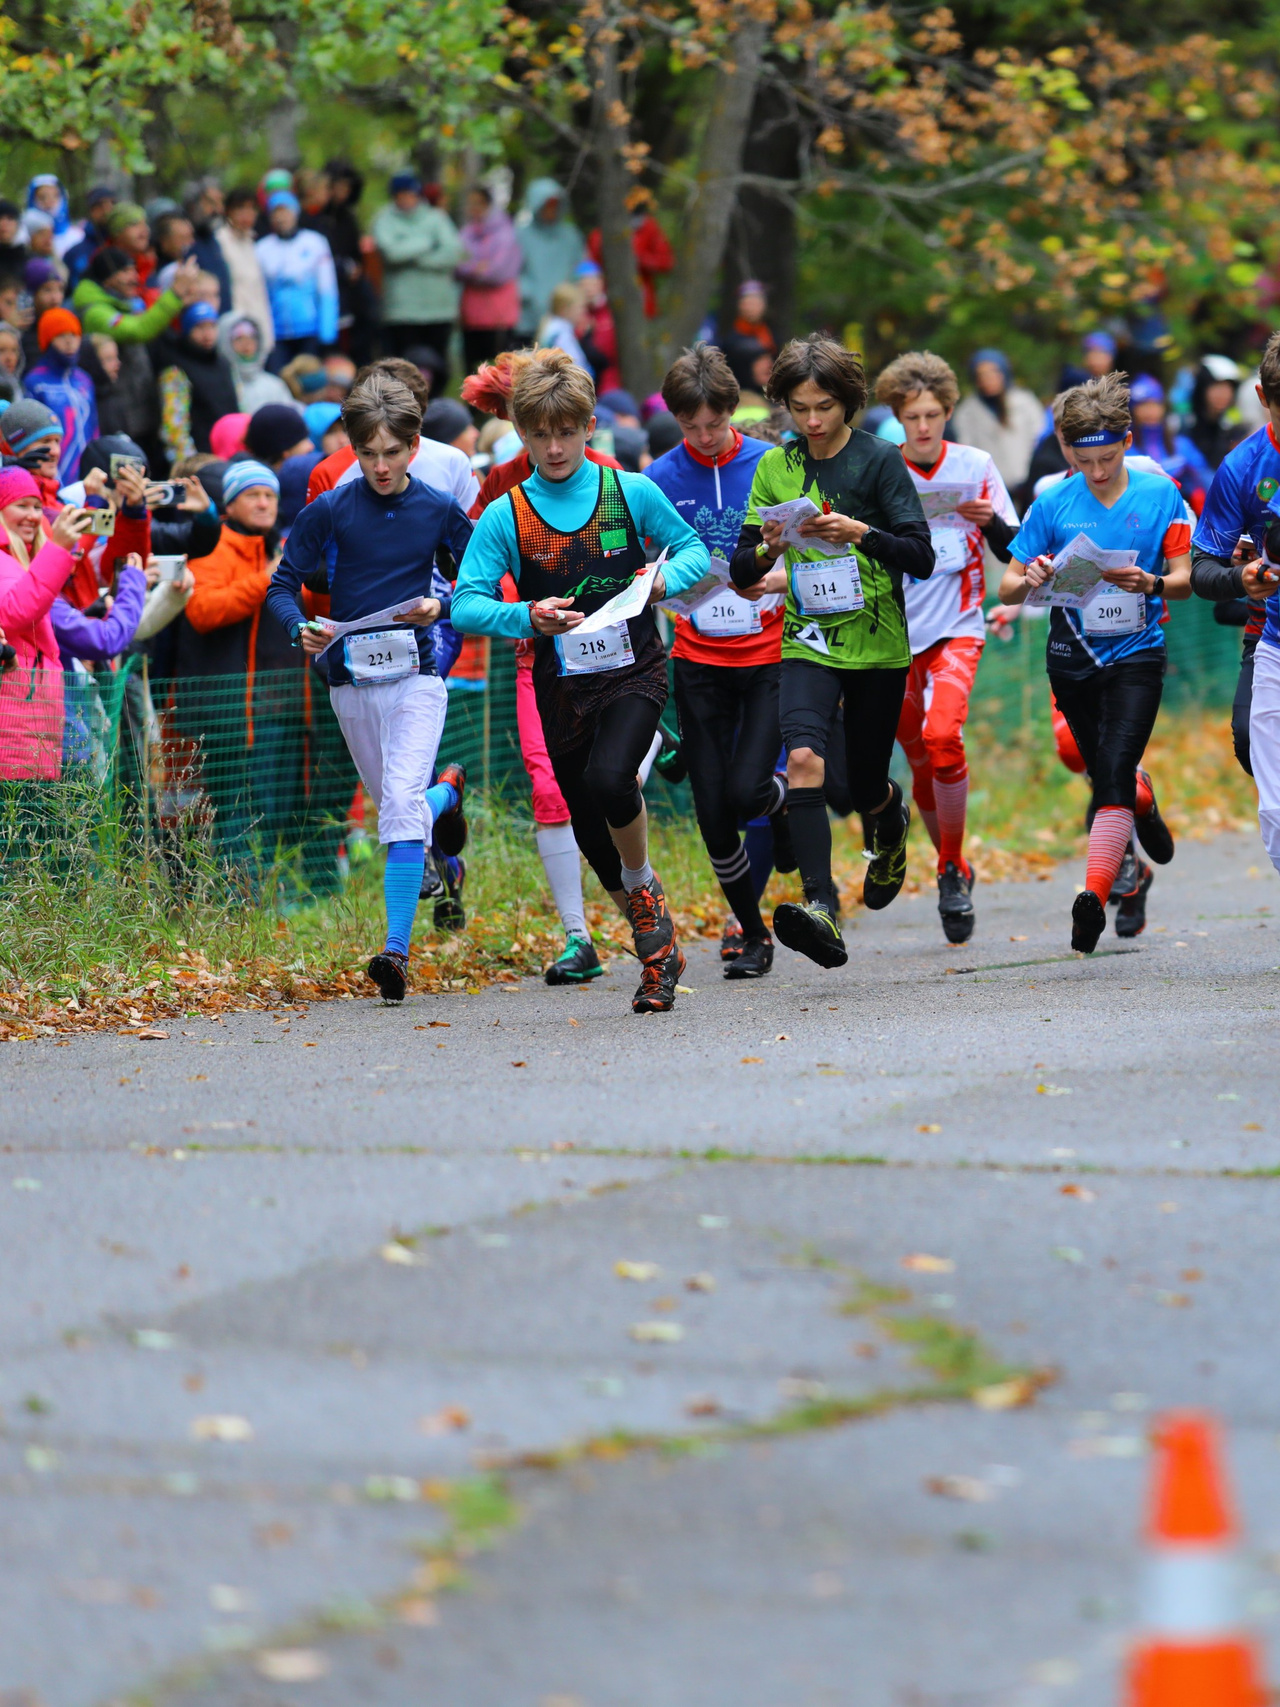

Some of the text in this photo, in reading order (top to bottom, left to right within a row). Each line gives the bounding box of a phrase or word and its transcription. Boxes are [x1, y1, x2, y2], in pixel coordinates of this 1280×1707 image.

[812, 582, 837, 596] 214
[712, 605, 735, 618] 216
[1098, 607, 1122, 618] 209
[579, 639, 606, 655] 218
[1050, 640, 1072, 652] ЛИГА
[367, 651, 393, 666] 224
